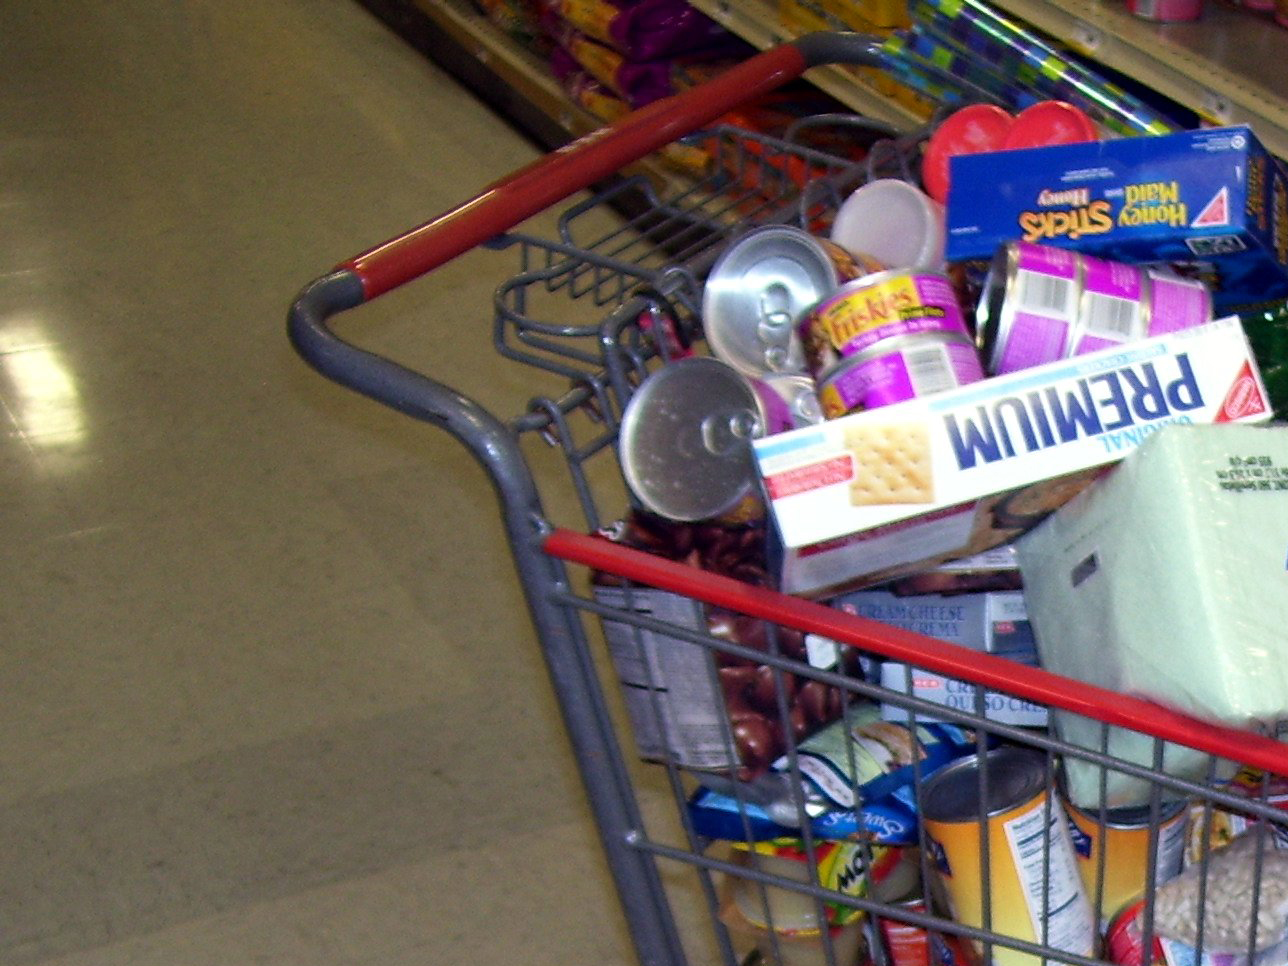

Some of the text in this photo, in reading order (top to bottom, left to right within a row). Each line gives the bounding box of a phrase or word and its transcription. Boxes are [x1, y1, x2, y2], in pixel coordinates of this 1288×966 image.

[1124, 181, 1179, 205] Maid
[1119, 203, 1186, 227] Honey
[943, 352, 1206, 471] PREMIUM
